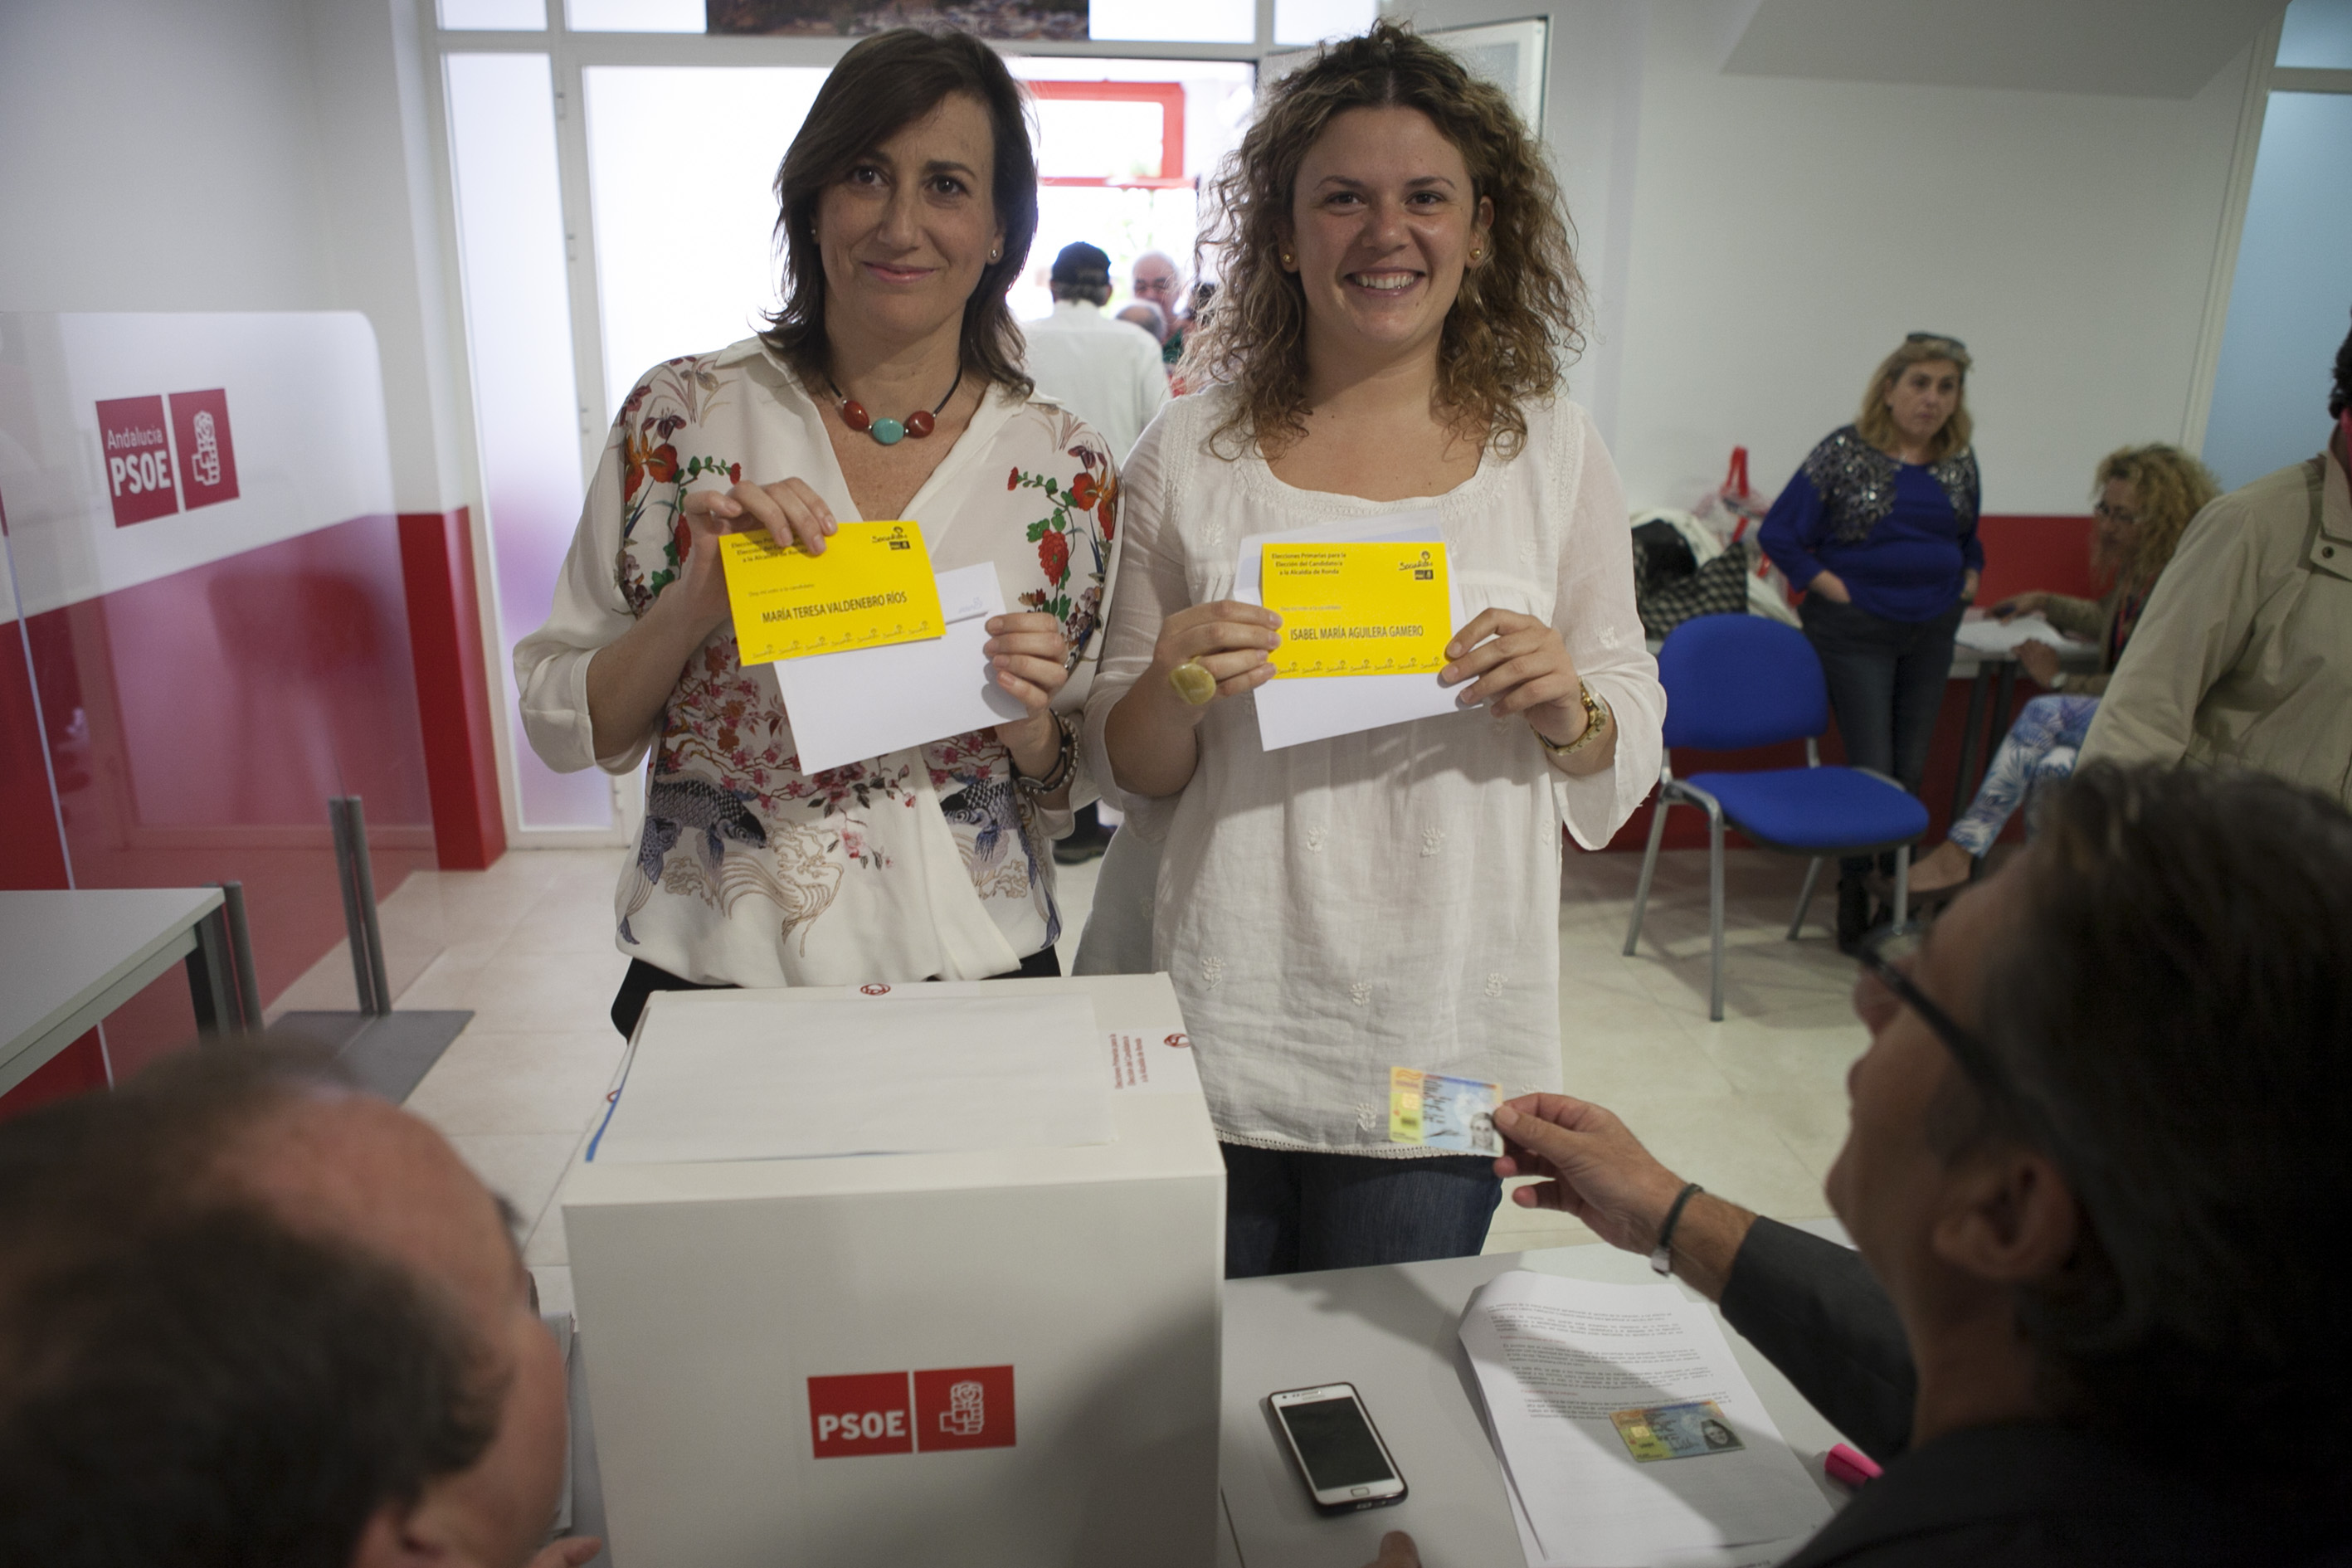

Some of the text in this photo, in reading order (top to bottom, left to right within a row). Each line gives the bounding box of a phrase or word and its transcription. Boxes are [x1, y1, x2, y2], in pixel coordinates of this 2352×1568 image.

[110, 450, 171, 497] PSOE
[762, 590, 907, 623] MARÍA TERESA VALDENEBRO RÍOS
[1290, 625, 1424, 641] ISABEL MARÍA AGUILERA GAMERO
[818, 1410, 906, 1441] PSOE
